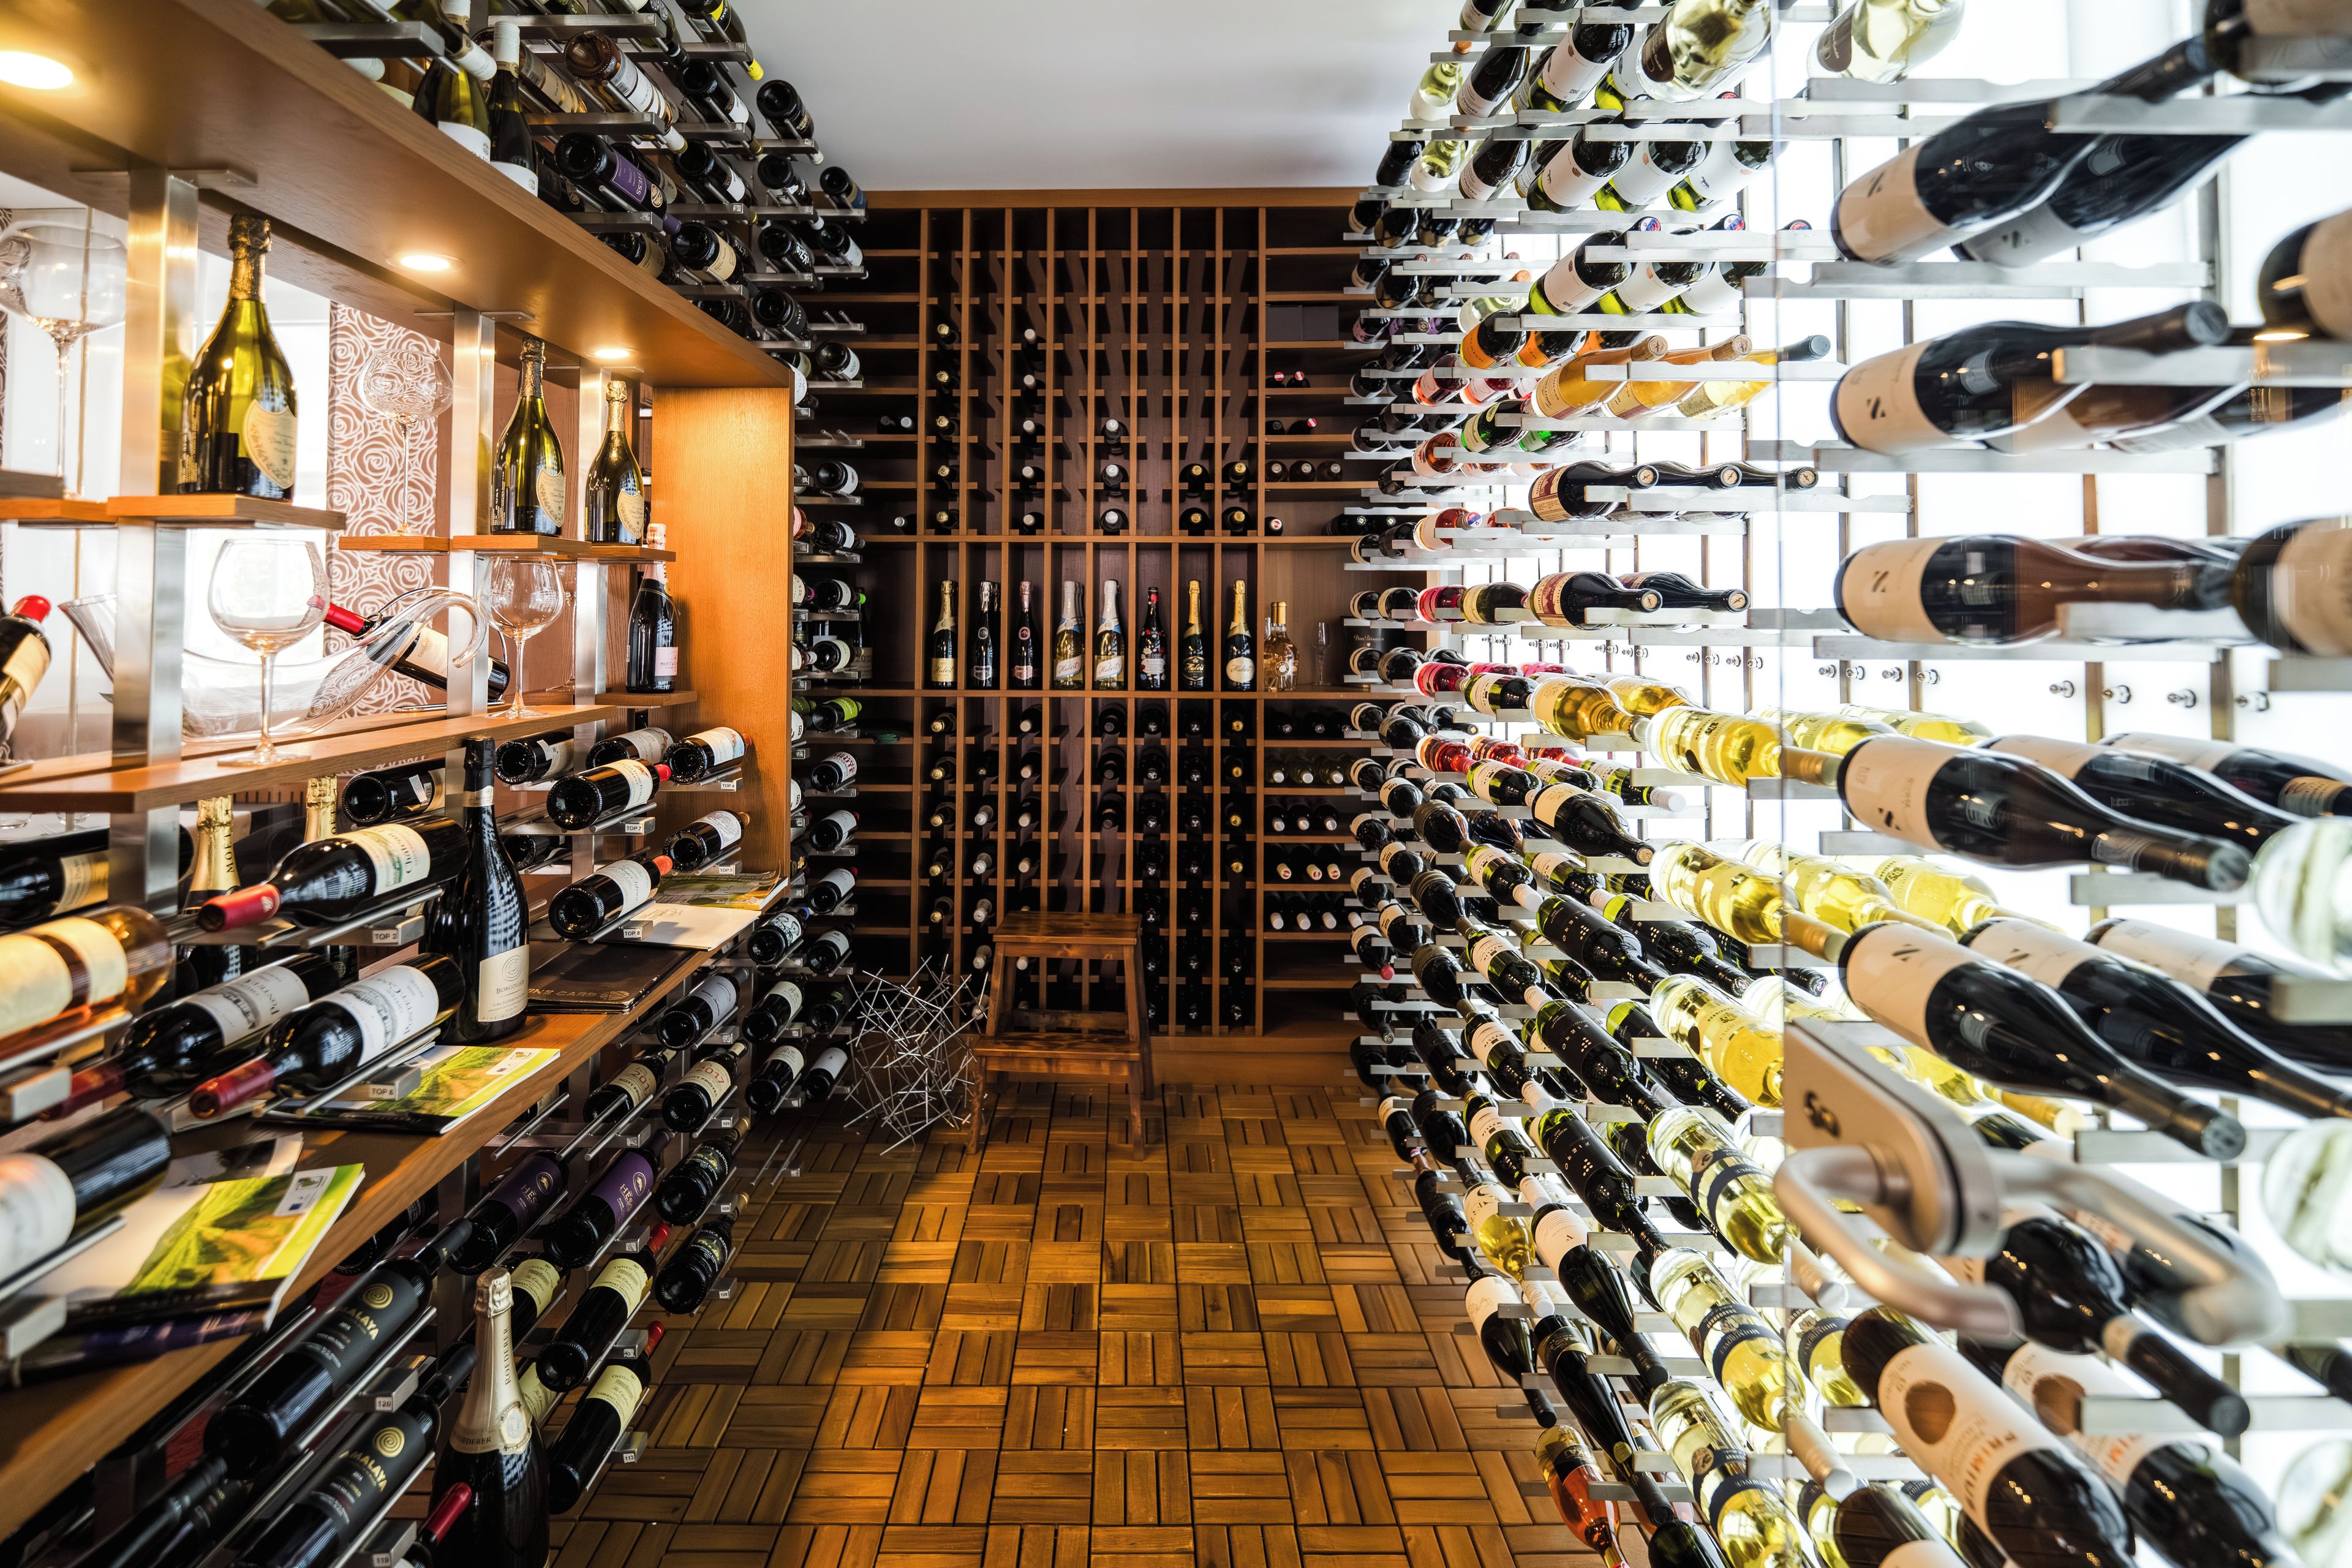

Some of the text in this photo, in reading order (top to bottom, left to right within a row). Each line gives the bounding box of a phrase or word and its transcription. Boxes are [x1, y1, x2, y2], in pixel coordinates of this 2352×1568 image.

[636, 172, 644, 196] HESS
[1059, 662, 1079, 673] Hubert
[1098, 662, 1120, 675] Hubert
[1187, 662, 1205, 671] Hubert
[1231, 663, 1253, 673] Hubert
[329, 809, 337, 835] OËT
[222, 832, 235, 873] MOËT
[255, 981, 281, 1016] PONTET
[400, 993, 413, 1035] PONTET
[619, 1078, 633, 1088] BOTT
[695, 1066, 725, 1084] 2017
[372, 1087, 388, 1095] TOP
[700, 1077, 718, 1098] FRIGYES
[619, 1183, 633, 1212] HESS
[503, 1328, 512, 1385] ROEDERER
[338, 1450, 388, 1493] AMALAYA
